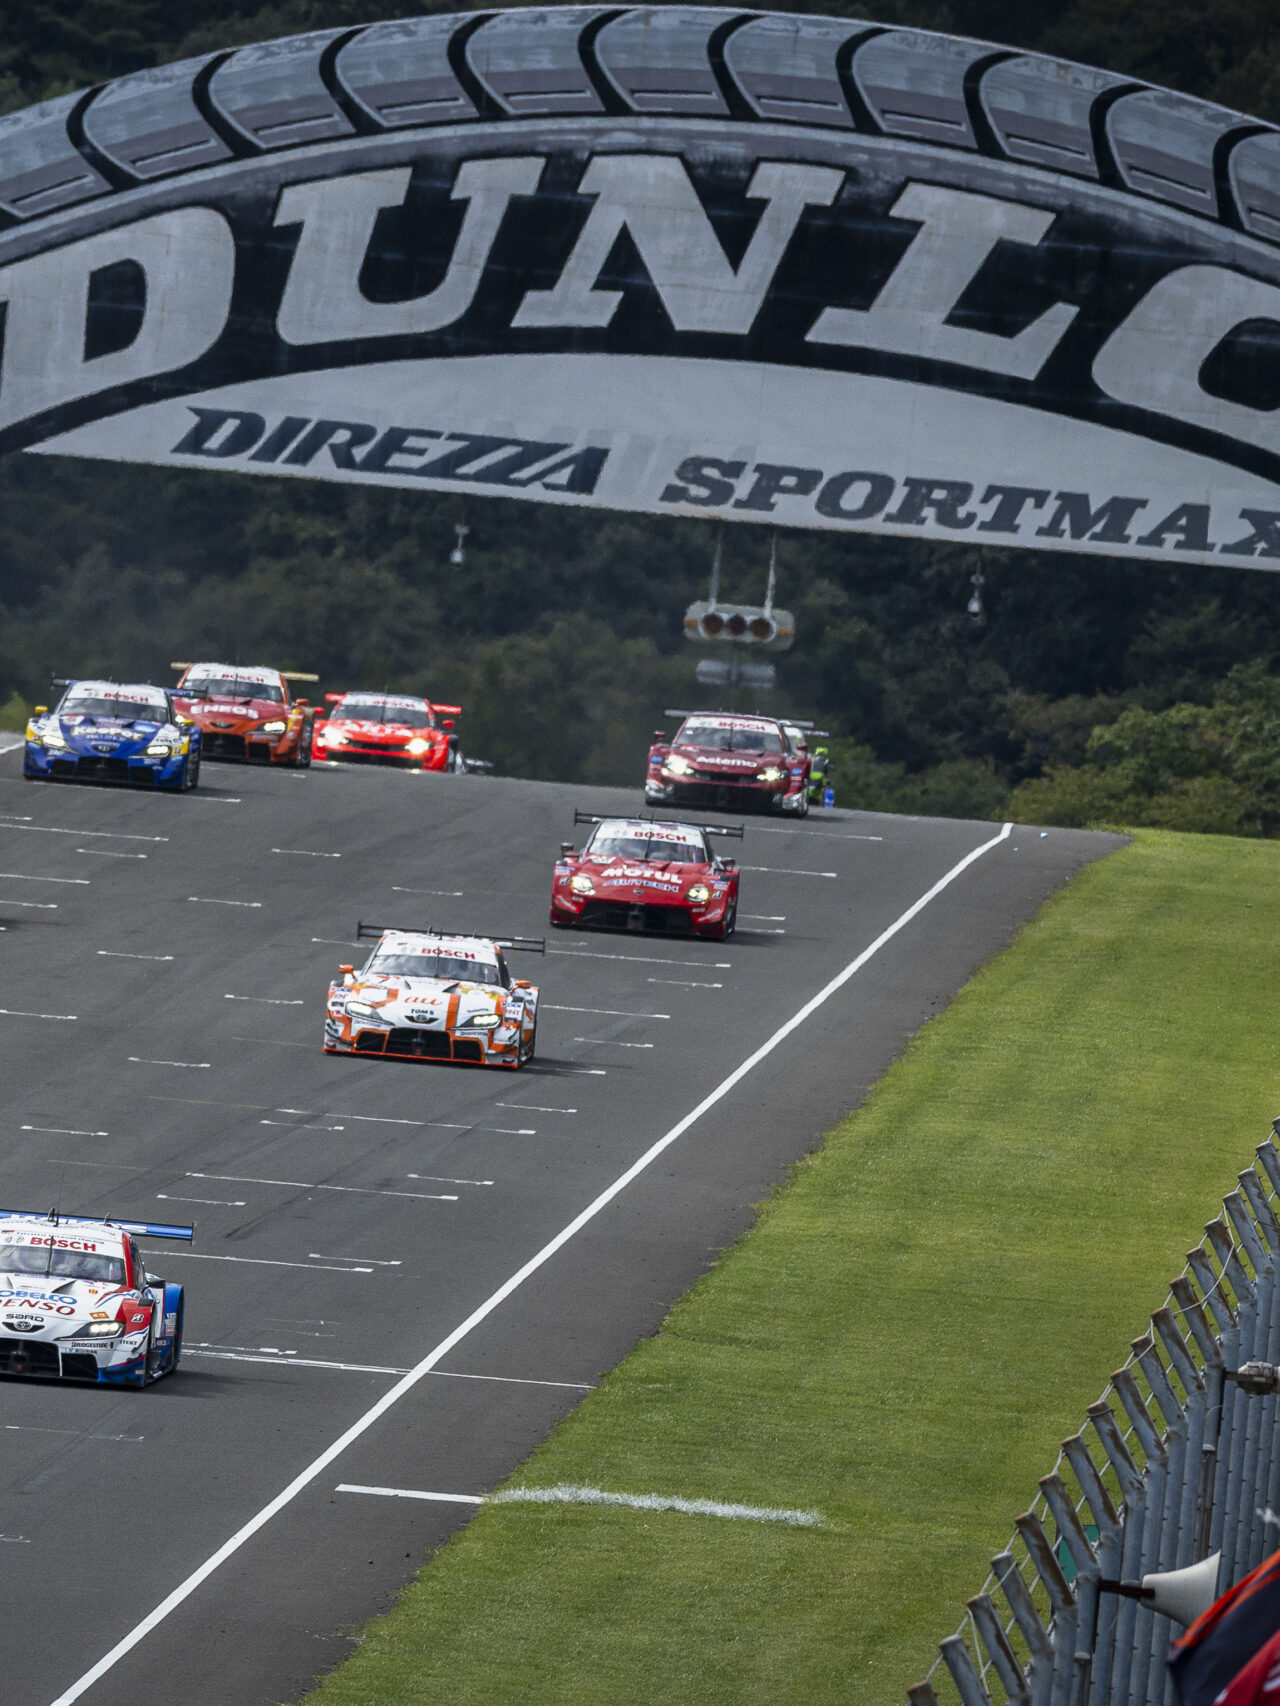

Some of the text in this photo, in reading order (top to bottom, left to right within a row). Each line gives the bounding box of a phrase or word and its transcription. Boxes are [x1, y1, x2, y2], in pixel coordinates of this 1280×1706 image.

[170, 406, 1280, 558] DIREZZA SPORTMAX
[190, 704, 259, 720] ENEOS
[634, 830, 687, 842] BOSCH
[601, 867, 683, 884] MOTUL
[421, 947, 476, 960] BOSCH
[30, 1236, 96, 1252] BOSCH
